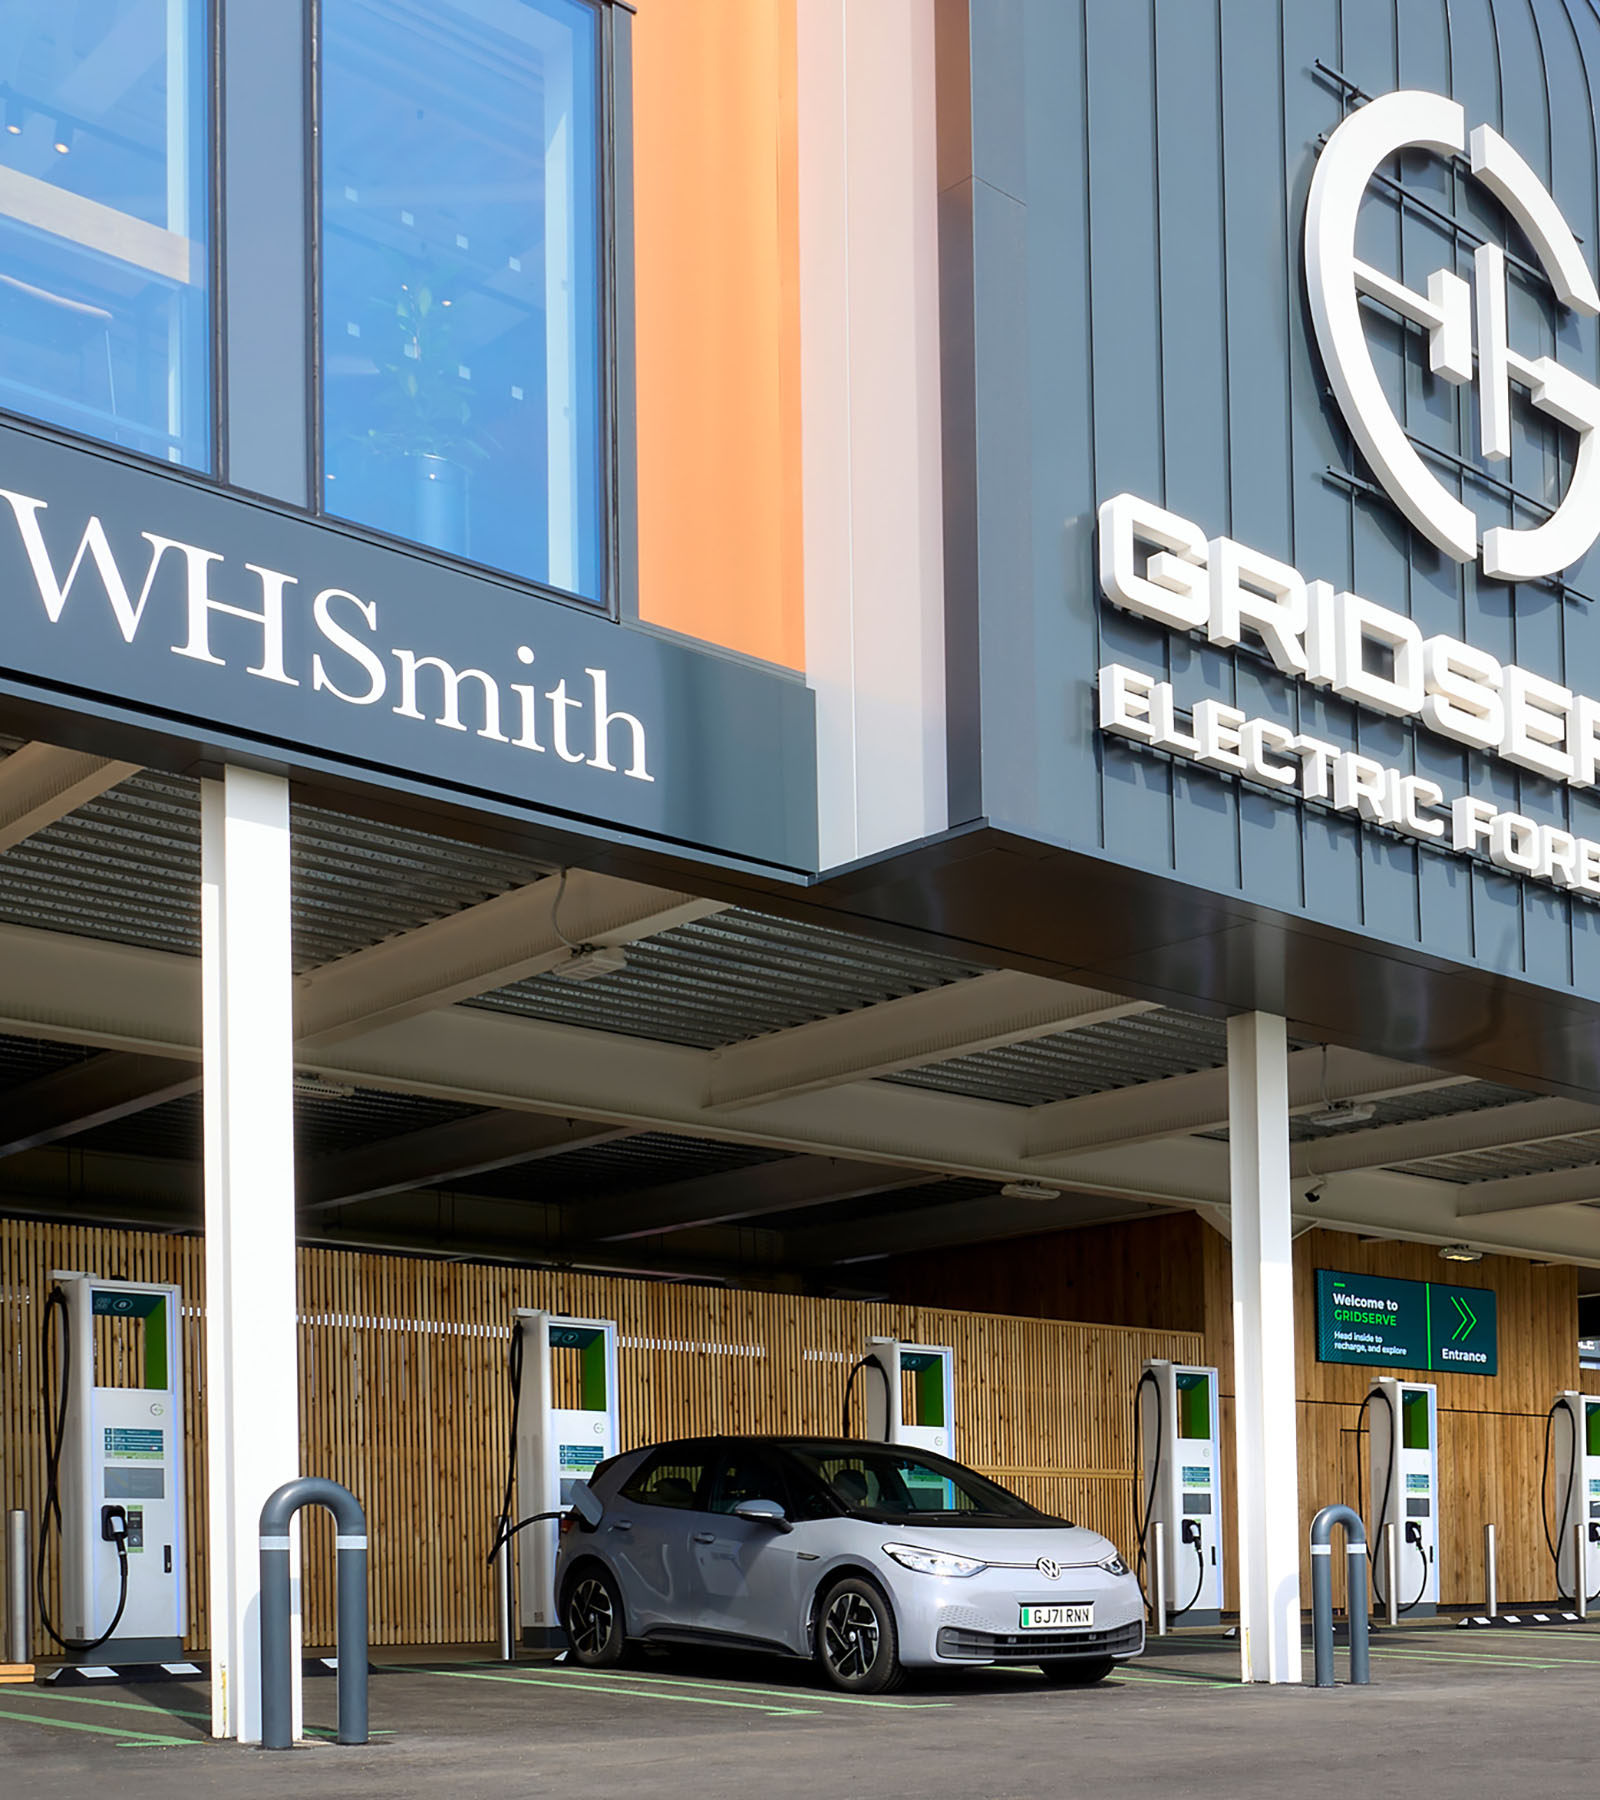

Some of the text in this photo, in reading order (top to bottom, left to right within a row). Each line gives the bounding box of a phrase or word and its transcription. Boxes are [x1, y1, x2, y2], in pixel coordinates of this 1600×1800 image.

[0, 489, 655, 782] WHSmith
[1098, 662, 1444, 838] ELECTRIC
[1332, 1292, 1399, 1311] Welcome to
[1334, 1309, 1397, 1327] GRIDSERVE
[1334, 1331, 1383, 1343] Head inside to
[1368, 1345, 1381, 1353] and
[1382, 1346, 1407, 1356] explore
[1441, 1348, 1487, 1363] Entrance
[1034, 1608, 1089, 1623] GJ71 RNN
